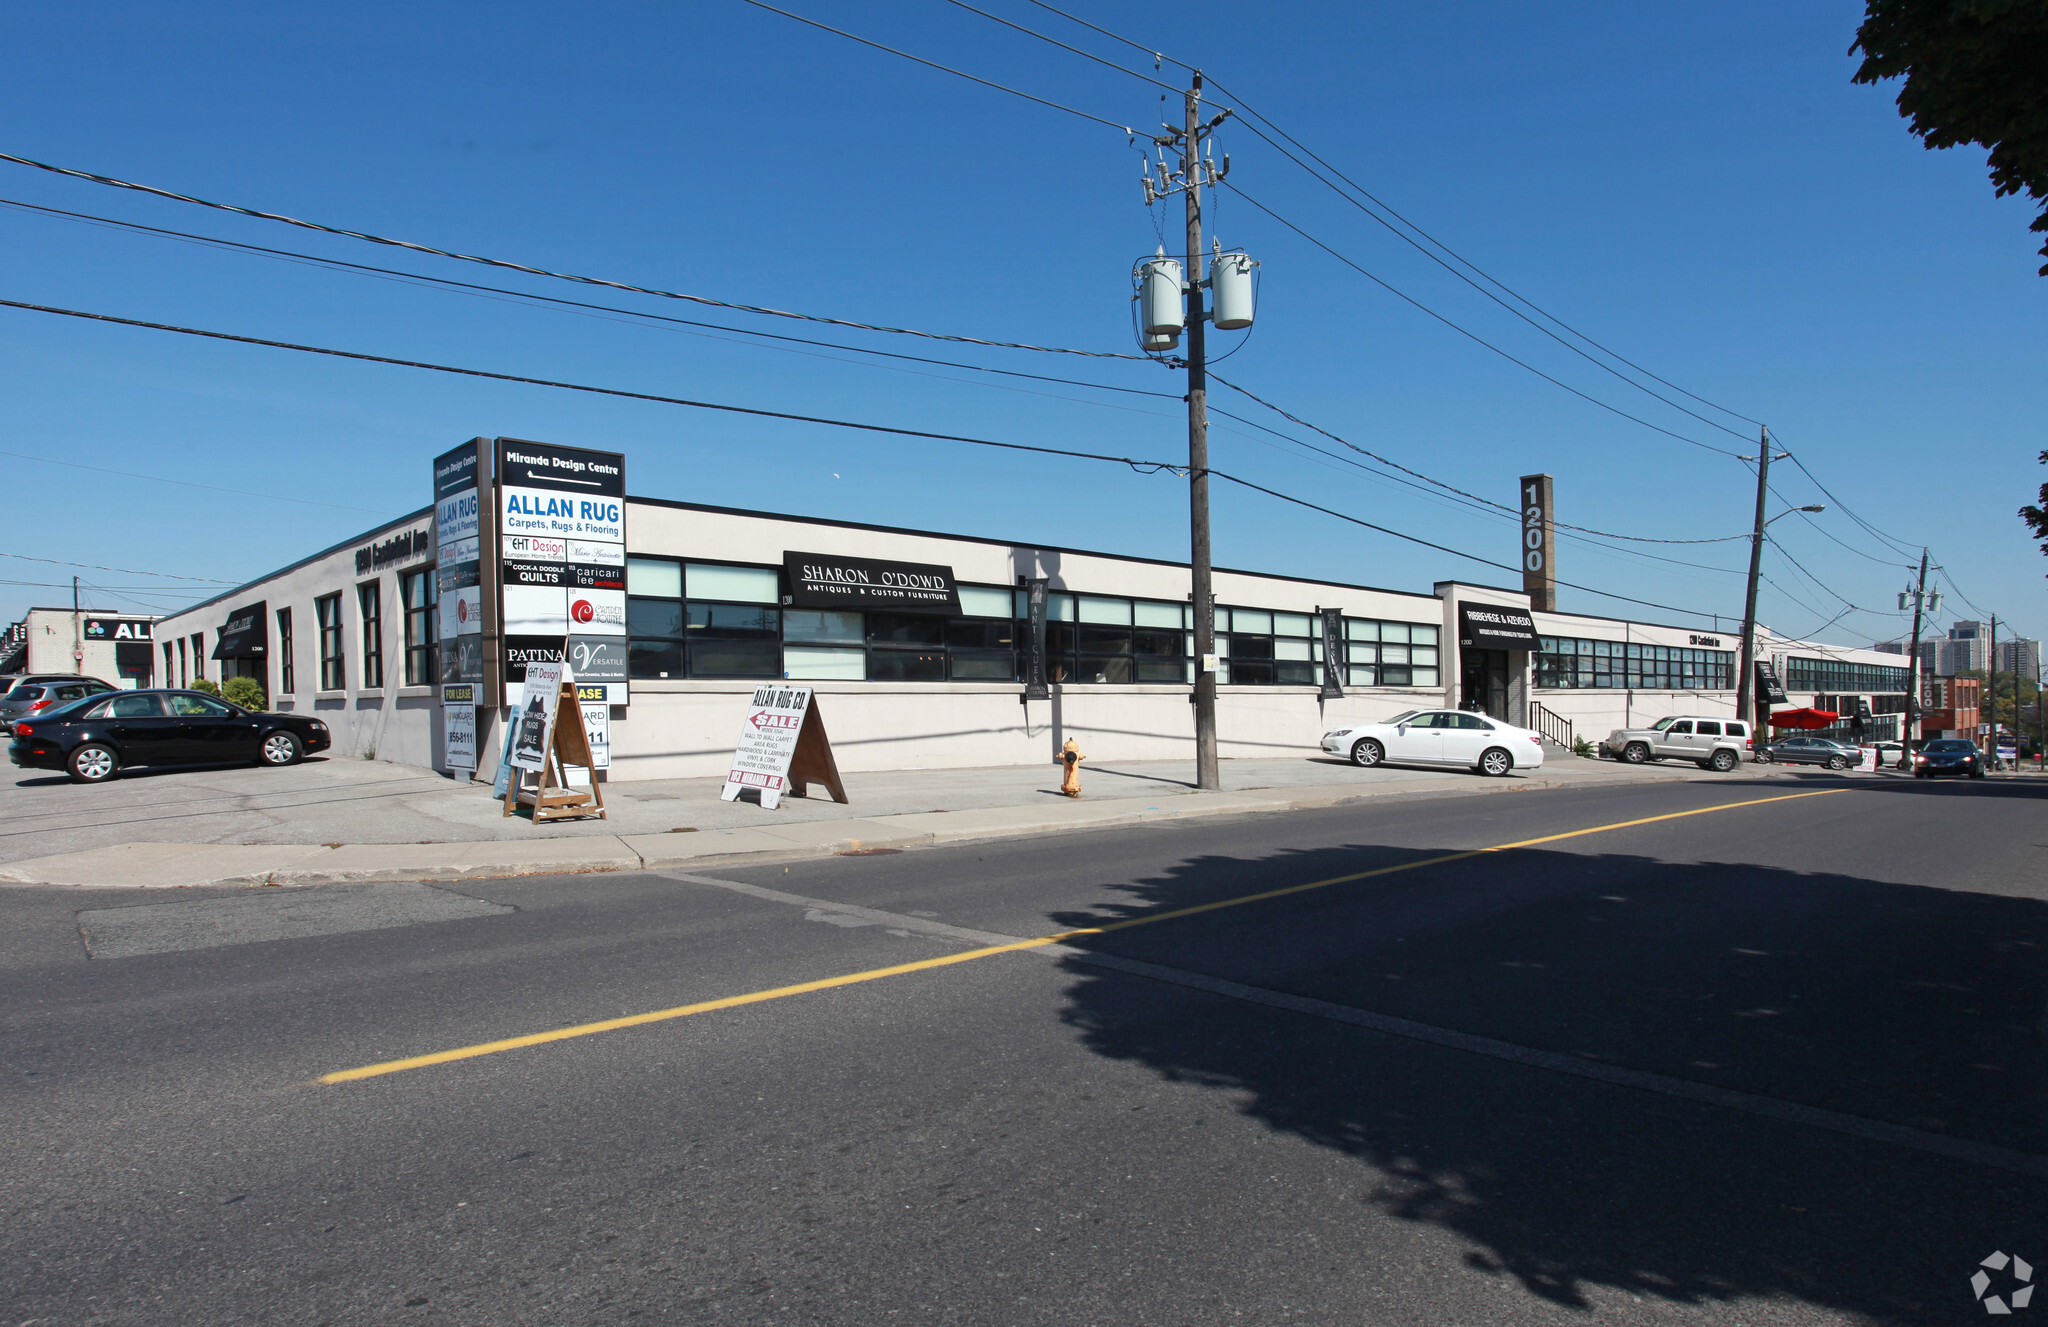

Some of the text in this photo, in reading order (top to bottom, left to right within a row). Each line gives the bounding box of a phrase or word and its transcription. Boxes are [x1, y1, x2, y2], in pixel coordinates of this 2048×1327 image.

[463, 455, 476, 466] Centre
[507, 452, 618, 475] Miranda Design Centre
[438, 496, 476, 525] ALLAN RUG
[507, 495, 618, 522] ALLAN RUG
[461, 520, 477, 530] Flooring
[509, 517, 618, 537] Carpets, Rugs & Flooring
[1526, 484, 1542, 571] 1200
[512, 538, 564, 556] EHT Design
[505, 551, 530, 559] European
[520, 572, 558, 583] QUILTS
[577, 568, 619, 578] caricari
[803, 565, 945, 589] SHARON O'DOWD
[577, 576, 594, 585] lee
[807, 585, 851, 593] ANTIQUES
[872, 589, 904, 598] CUSTOM
[908, 592, 947, 600] FURNITURE
[783, 596, 792, 605] 1200
[595, 605, 622, 614] CAMDEN
[596, 614, 622, 624] TOWNE
[1501, 615, 1506, 623] &
[1507, 615, 1531, 626] AZEVEDO
[508, 649, 566, 661] PATINA
[574, 642, 624, 672] VERSATILE
[528, 667, 558, 682] EHT Design
[446, 689, 471, 699] FOR LEASE
[1924, 672, 1932, 706] 1200
[752, 690, 806, 710] ALLAN RUG CO.
[526, 721, 538, 729] RUGS
[755, 714, 799, 728] SALE
[524, 734, 536, 744] SALE
[757, 762, 782, 771] COVERINGS
